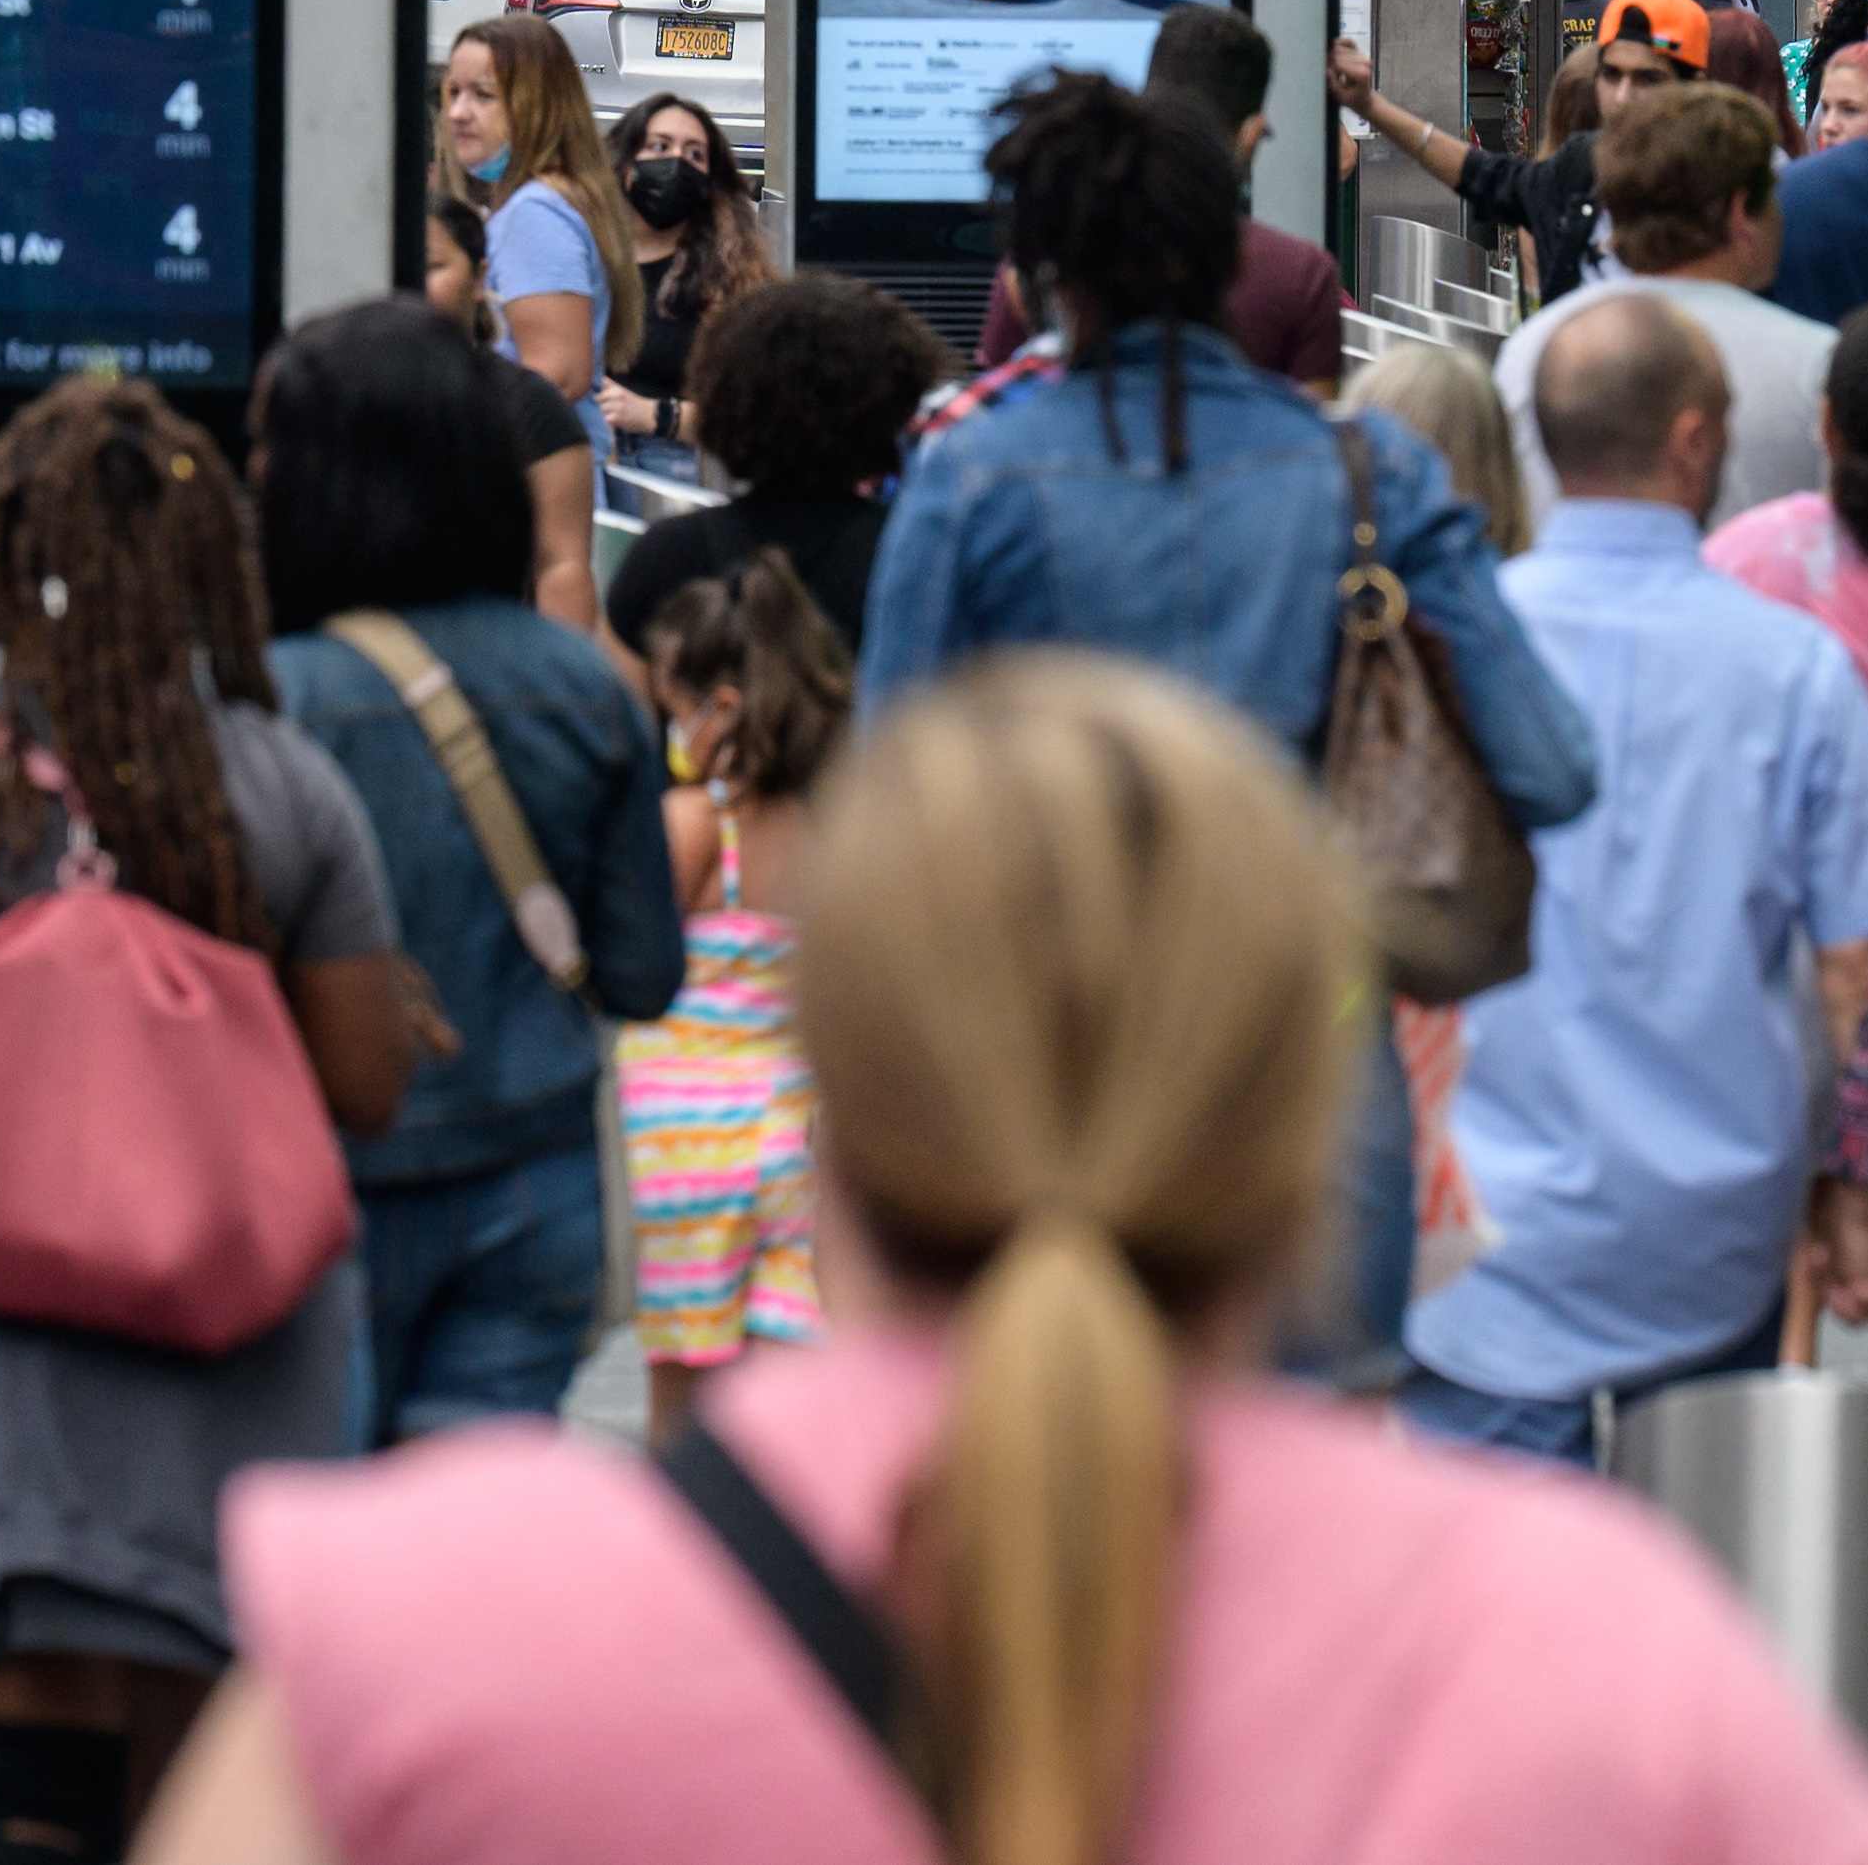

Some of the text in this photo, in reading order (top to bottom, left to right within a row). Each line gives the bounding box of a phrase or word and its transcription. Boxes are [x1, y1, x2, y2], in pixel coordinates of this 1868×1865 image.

[21, 109, 53, 141] St
[164, 81, 200, 130] 4
[21, 233, 63, 265] Av
[163, 205, 199, 254] 4
[15, 340, 54, 370] for
[148, 339, 210, 369] info
